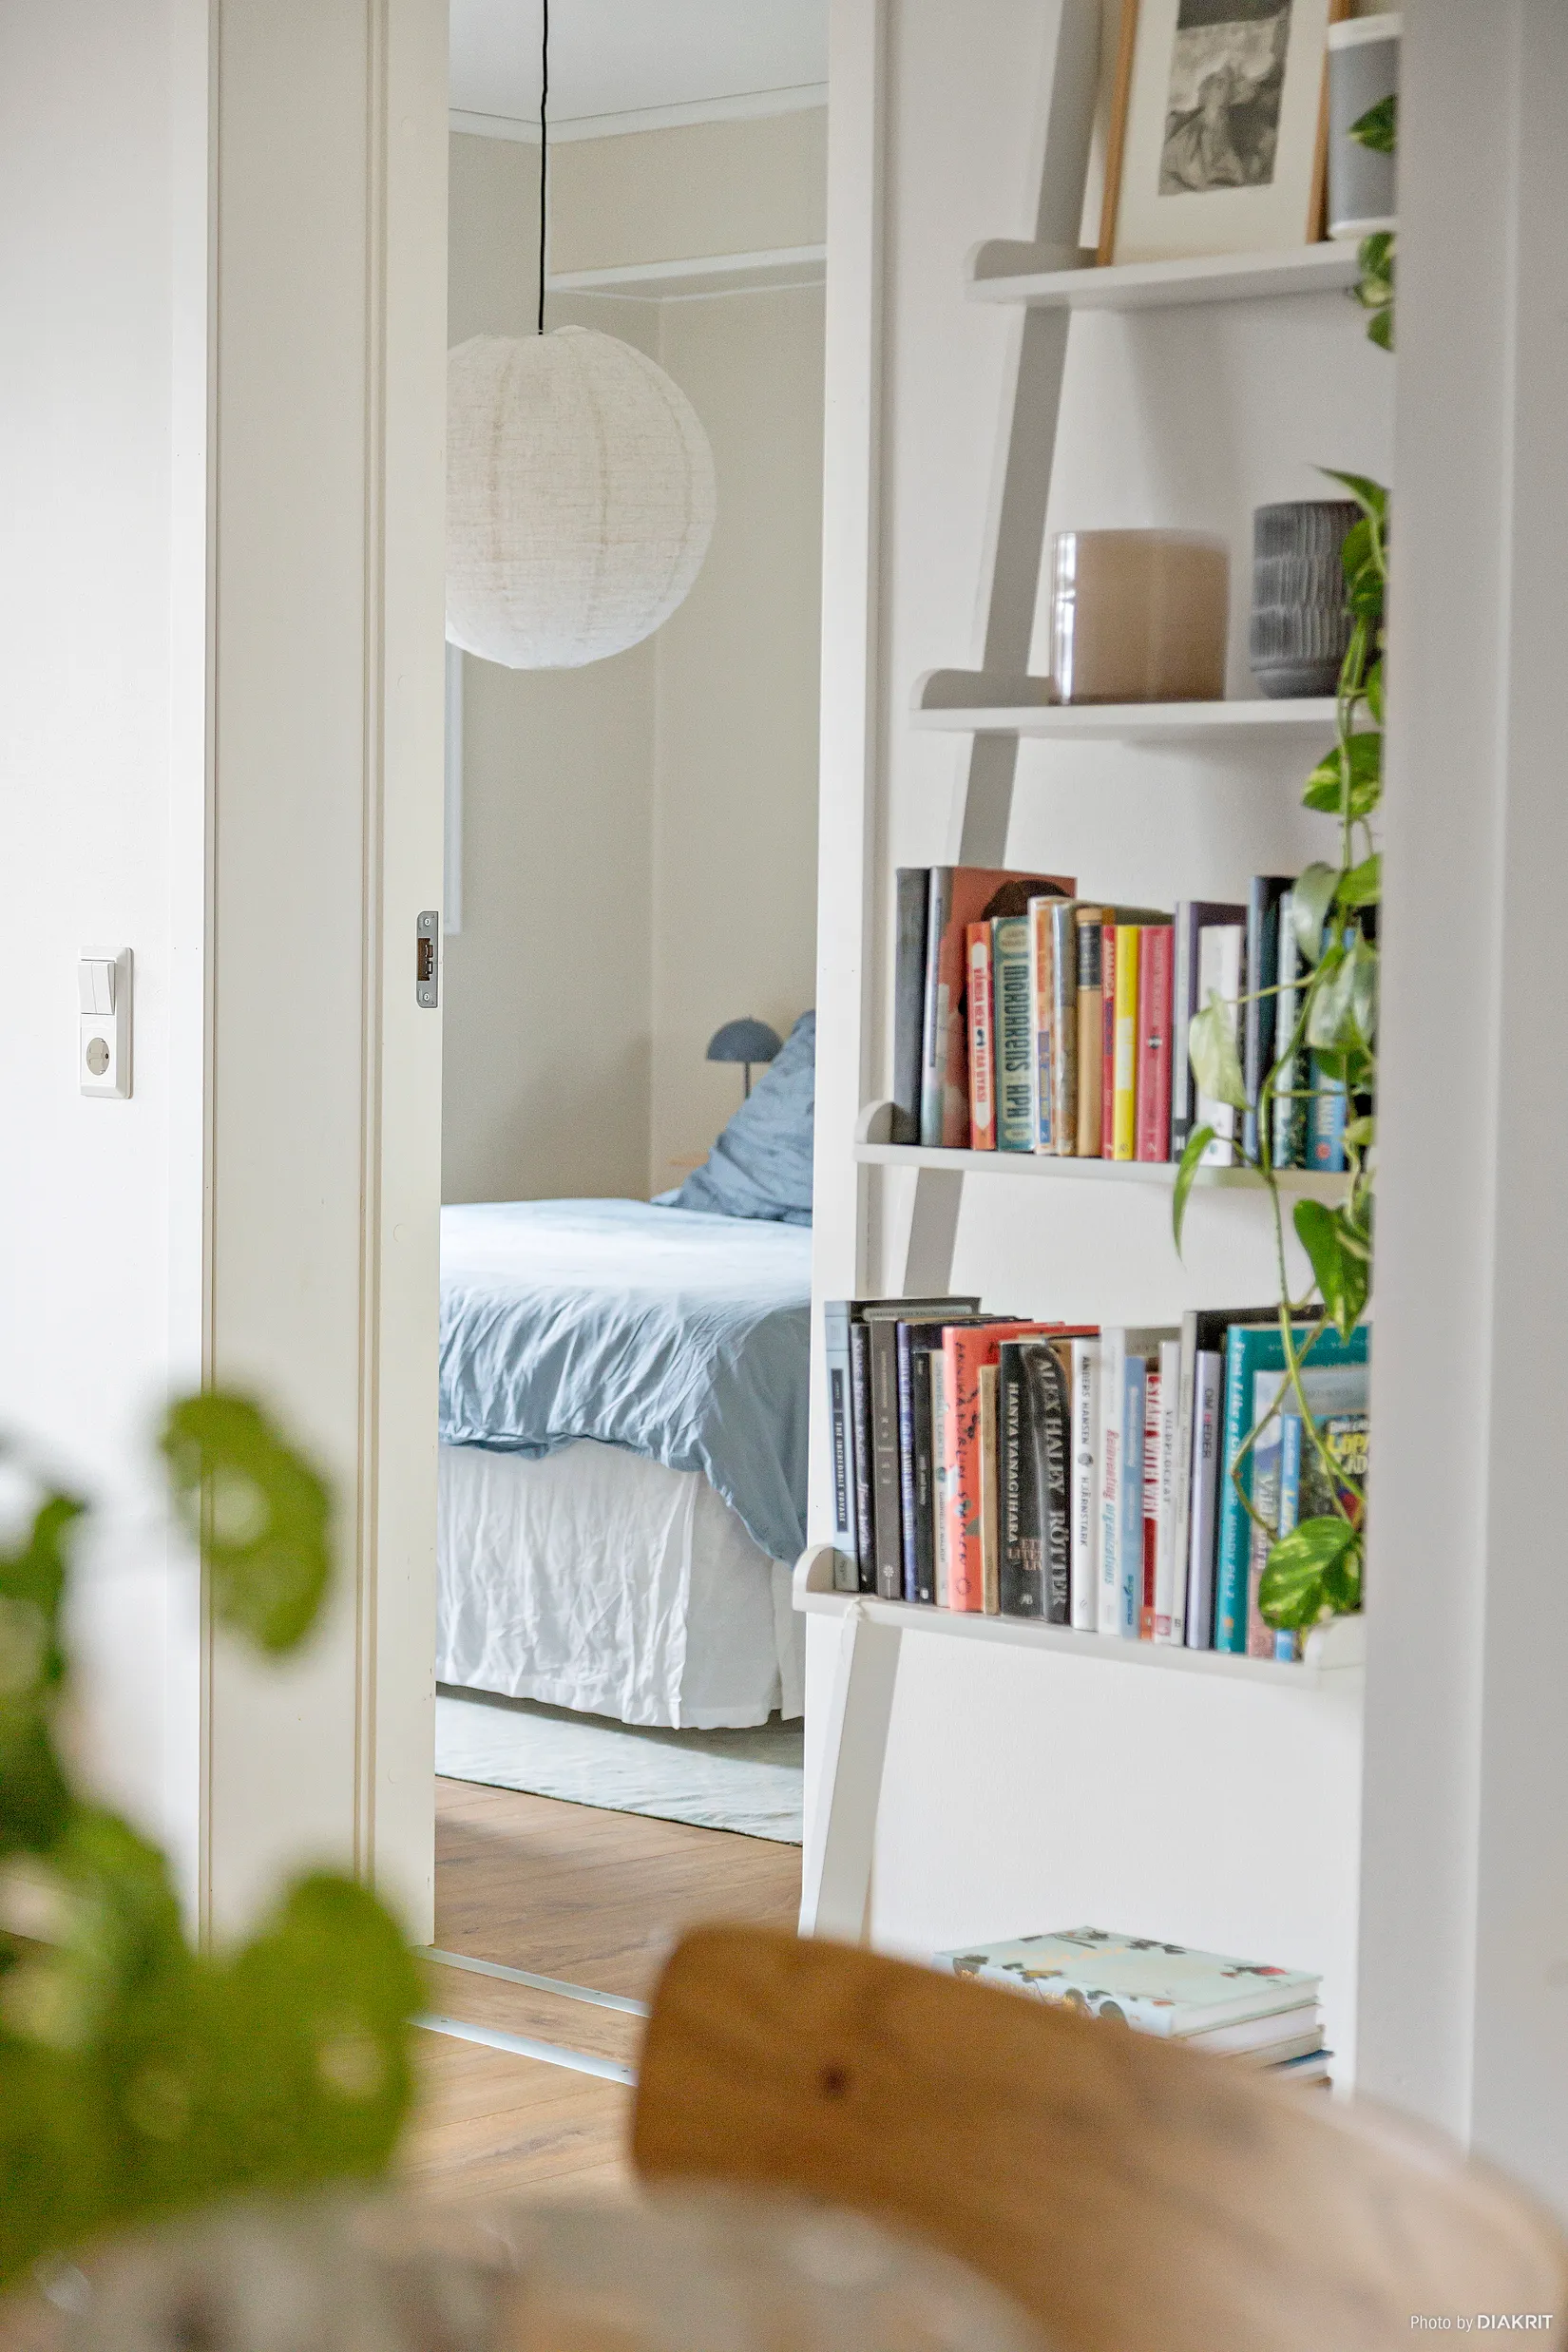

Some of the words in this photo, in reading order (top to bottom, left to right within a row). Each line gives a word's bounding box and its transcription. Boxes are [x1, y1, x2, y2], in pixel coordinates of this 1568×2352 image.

[1036, 1359, 1061, 1410] ALEX
[1080, 1356, 1091, 1397] ANDERS
[1204, 1388, 1214, 1410] OM
[1231, 1381, 1244, 1418] Like
[834, 1422, 843, 1437] THE
[1007, 1382, 1019, 1436] HANYA
[1080, 1402, 1091, 1444] HANSEN
[1202, 1413, 1214, 1459] HEDER
[1044, 1417, 1066, 1493] HALEY
[1103, 1428, 1119, 1501] Reinventing
[1163, 1408, 1174, 1505] VILDPLOCKAT
[1007, 1440, 1019, 1542] YANAGIHARA
[1080, 1476, 1091, 1546] HJÄRNSTARK
[1048, 1510, 1069, 1606] RÖTTER
[1102, 1502, 1119, 1585] organizations
